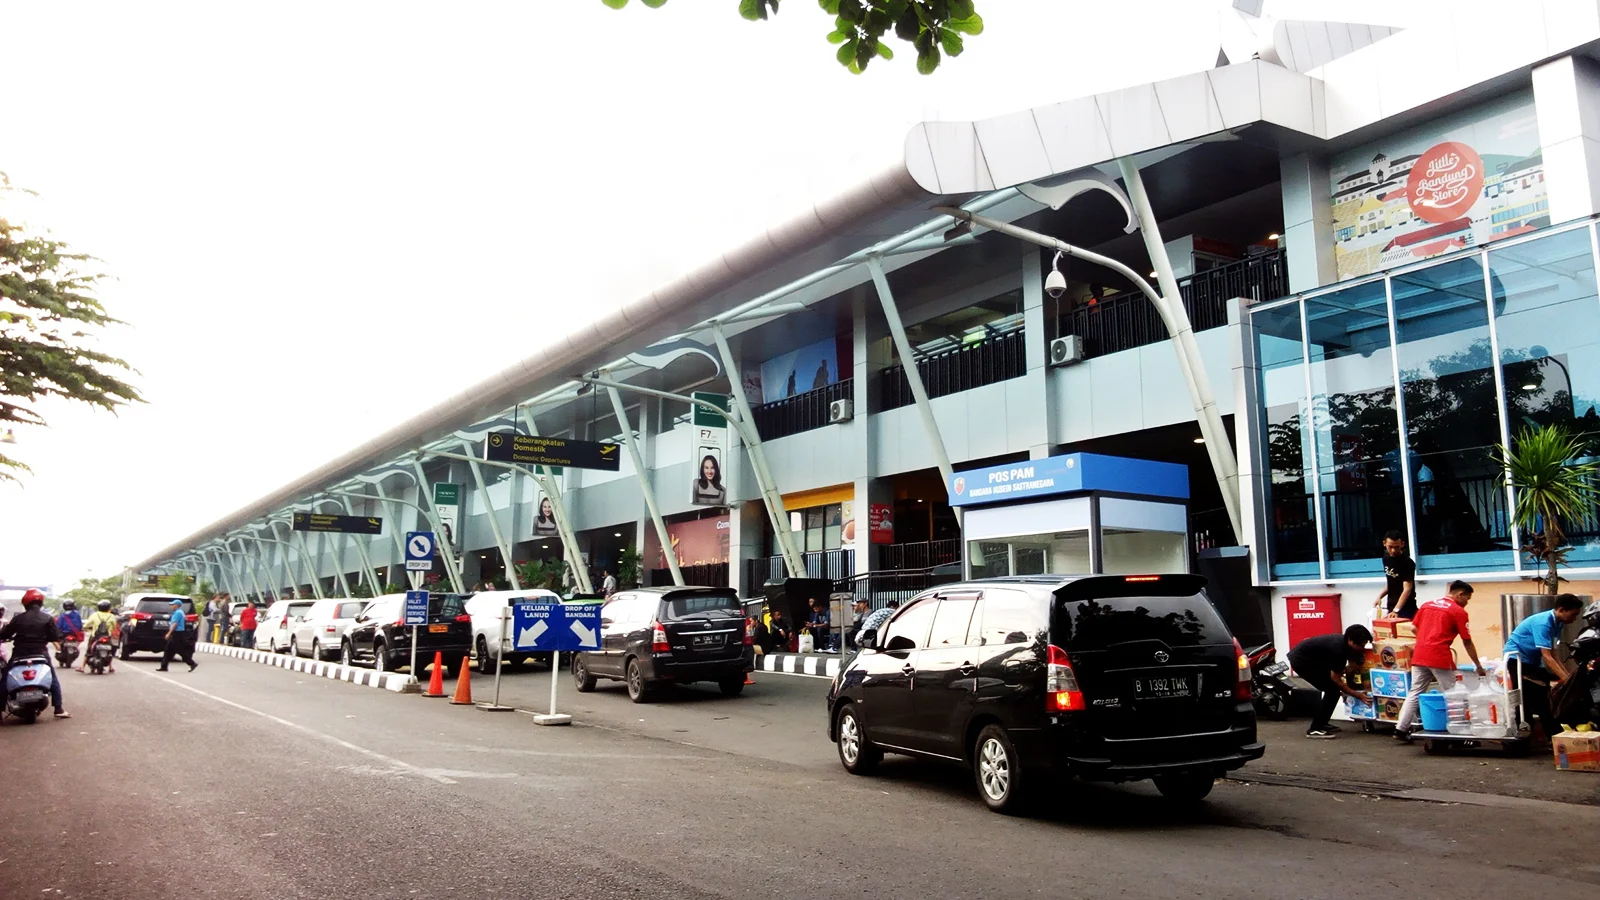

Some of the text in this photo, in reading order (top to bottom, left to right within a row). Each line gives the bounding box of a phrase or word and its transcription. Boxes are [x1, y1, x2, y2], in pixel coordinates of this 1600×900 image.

[1426, 153, 1459, 177] Little
[1415, 163, 1475, 196] Bandung
[1424, 186, 1468, 206] Store
[700, 429, 711, 438] F7
[513, 436, 565, 447] Keberangkatan
[513, 444, 546, 453] Domestik
[513, 453, 539, 461] Domestic
[988, 469, 1011, 484] POS
[1010, 466, 1035, 480] PAM
[1135, 680, 1142, 692] B
[1149, 679, 1169, 691] 1392
